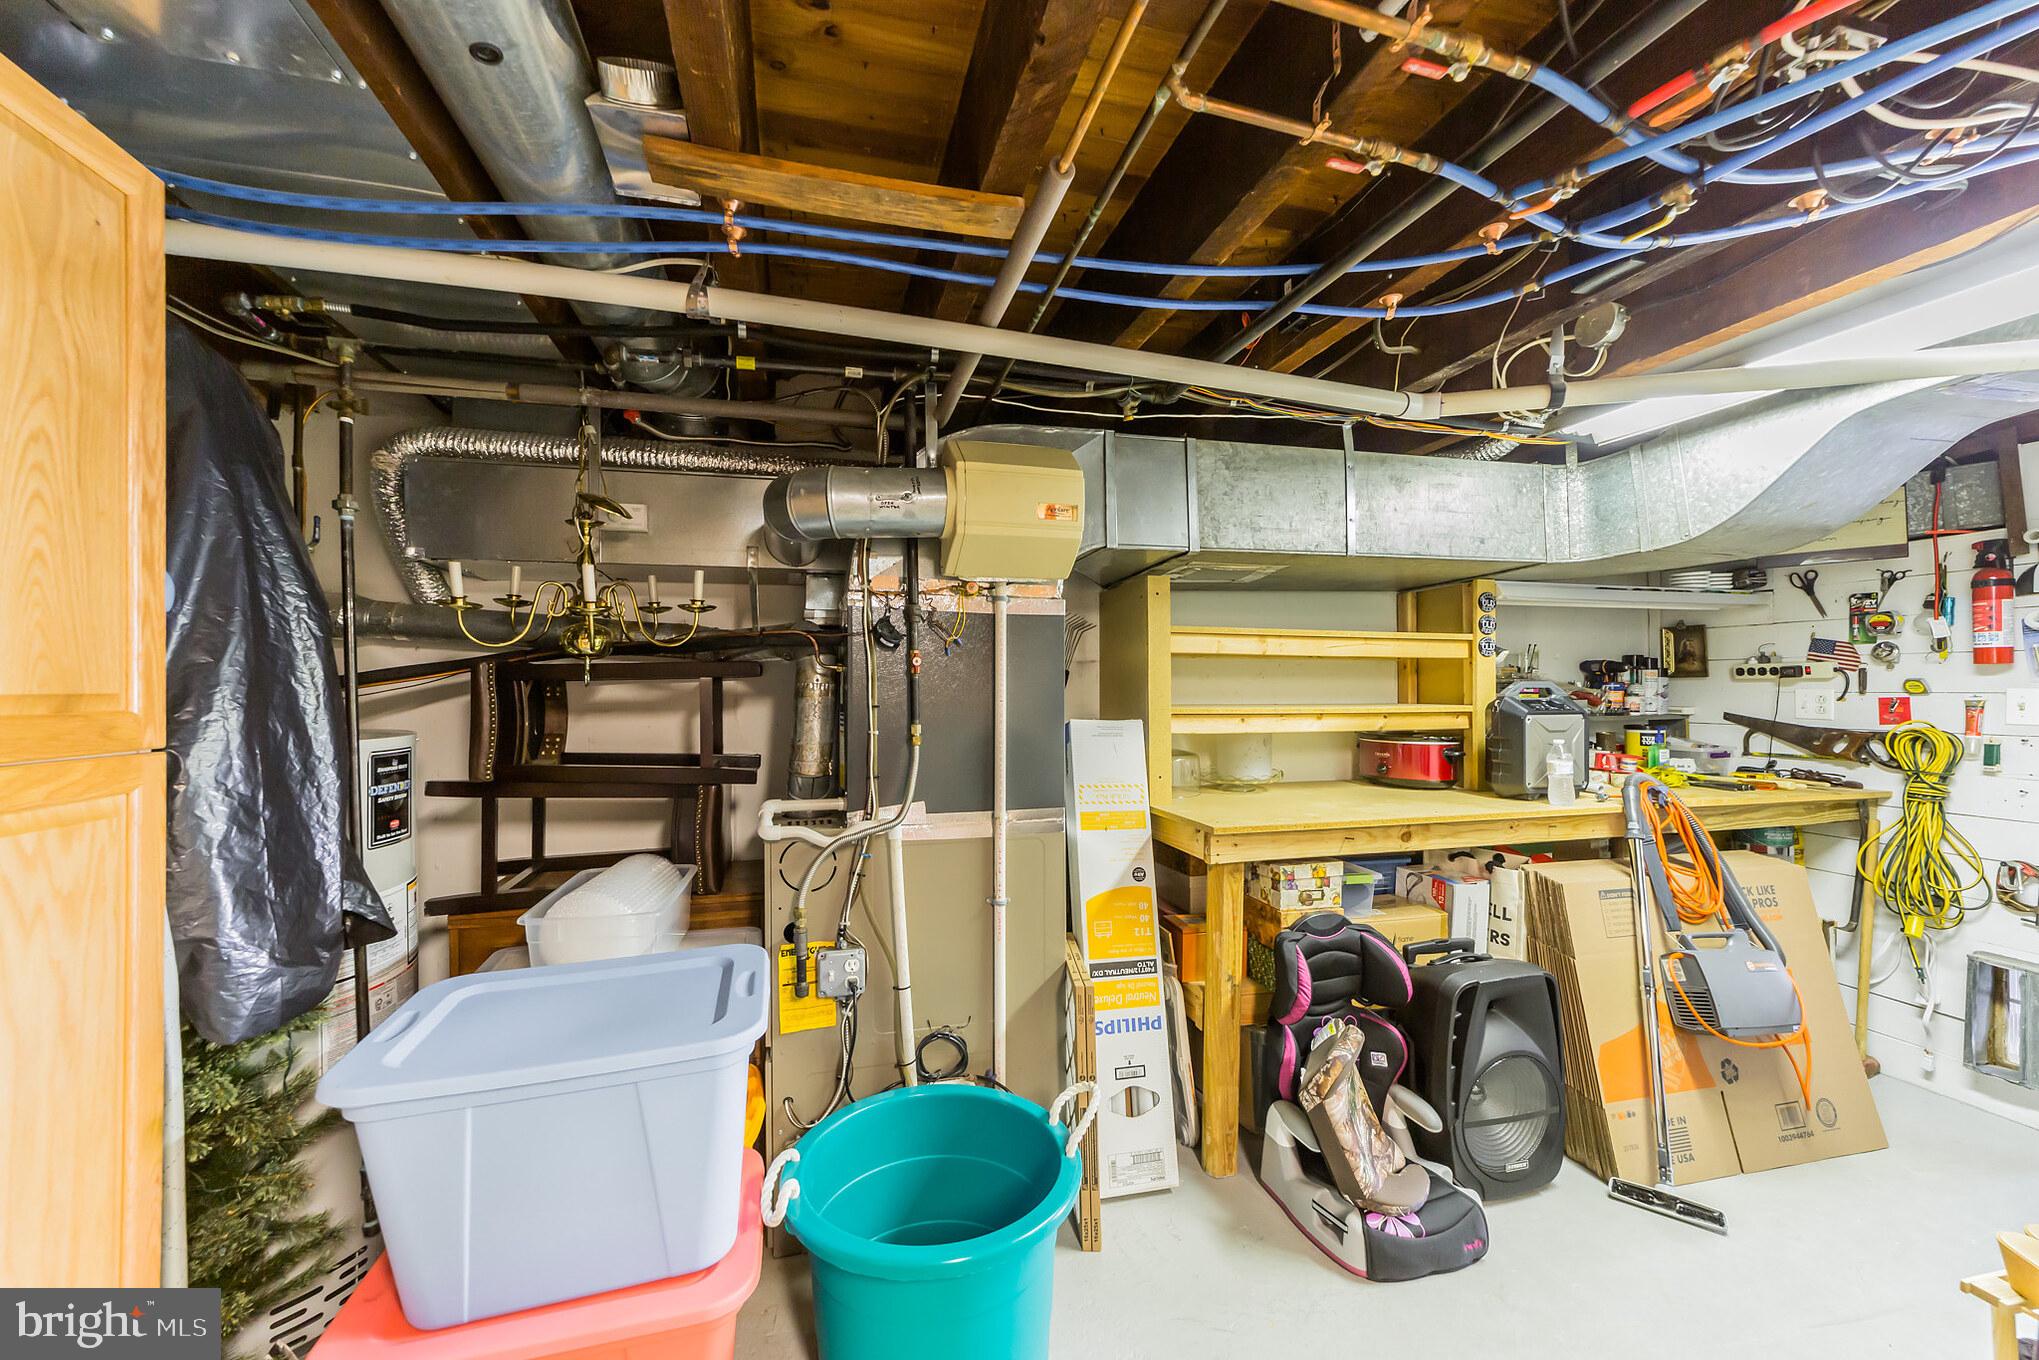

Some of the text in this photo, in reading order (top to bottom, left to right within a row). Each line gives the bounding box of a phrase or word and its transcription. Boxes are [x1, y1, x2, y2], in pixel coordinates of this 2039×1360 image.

[1756, 885, 1776, 896] LIKE
[1752, 897, 1778, 908] PROS
[1125, 991, 1157, 1005] Neutral
[1094, 1015, 1163, 1036] PHILIPS
[1677, 1153, 1695, 1163] USA
